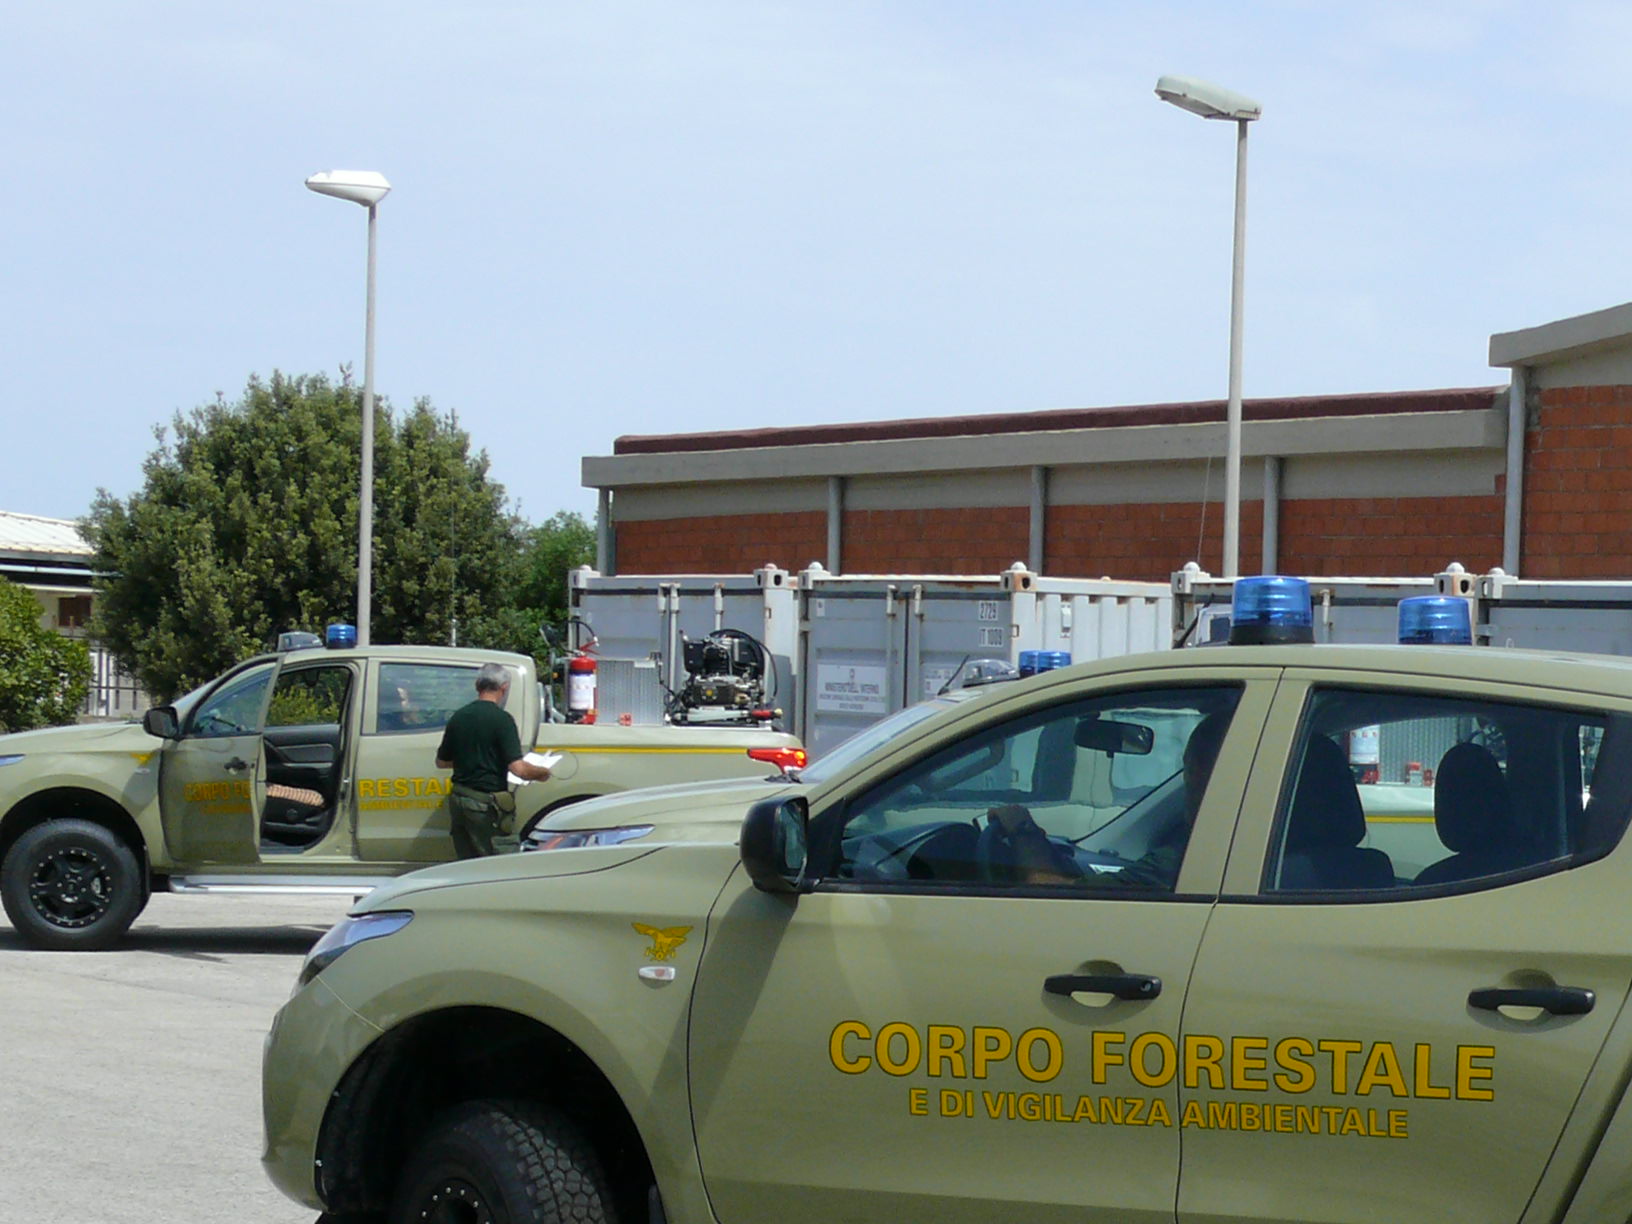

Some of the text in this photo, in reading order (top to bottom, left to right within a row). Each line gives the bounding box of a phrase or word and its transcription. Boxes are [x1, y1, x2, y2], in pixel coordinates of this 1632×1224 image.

[829, 1020, 1496, 1102] CORPO FORESTALE
[909, 1088, 1409, 1139] E DI VIGILANZA AMBIENTALE
